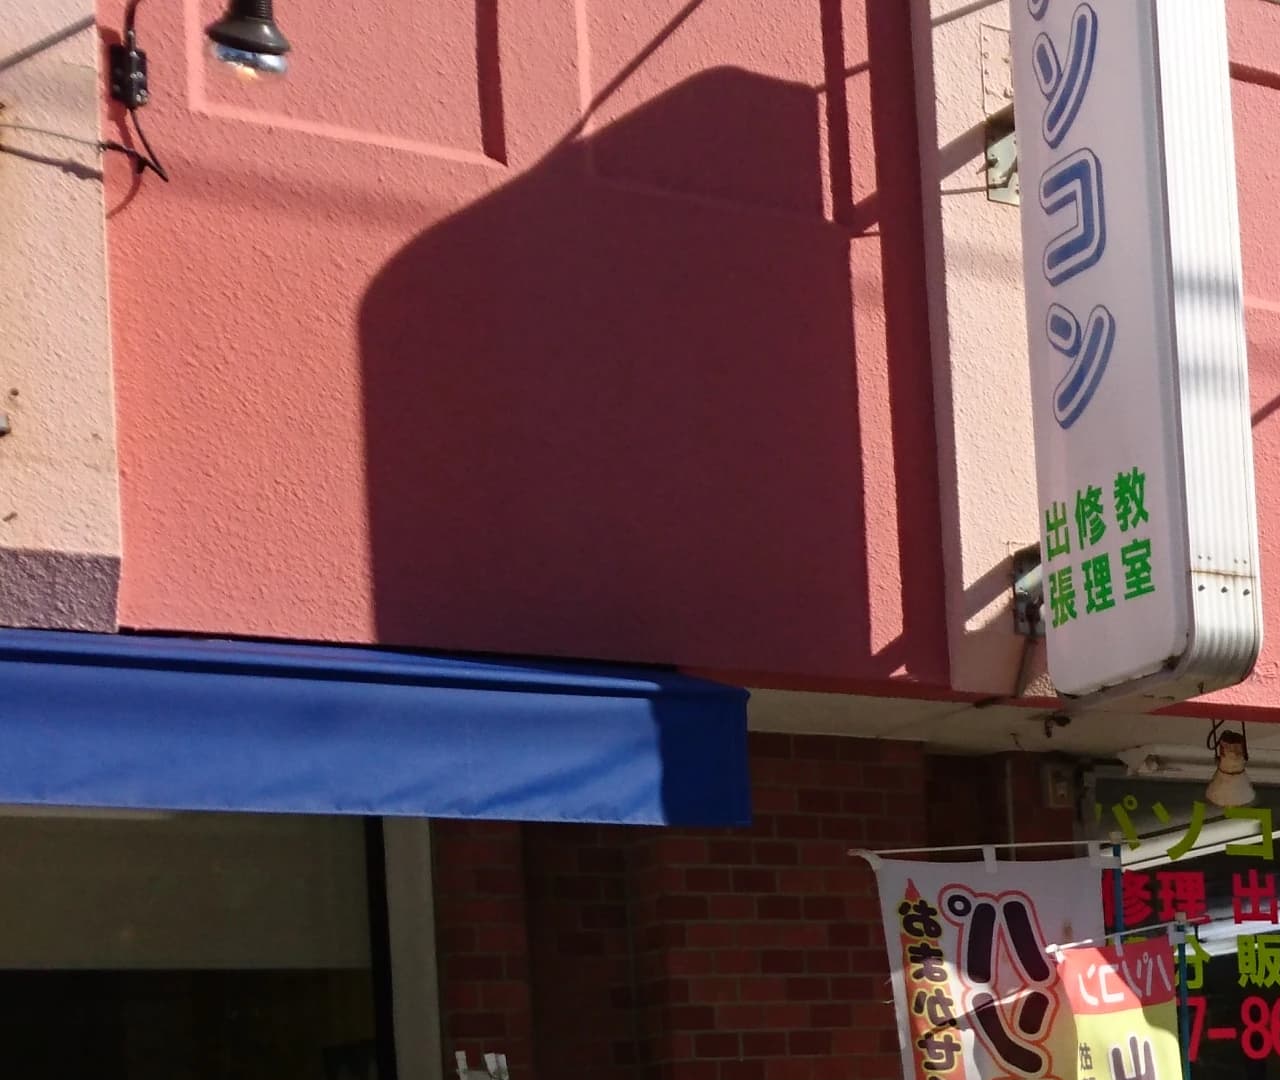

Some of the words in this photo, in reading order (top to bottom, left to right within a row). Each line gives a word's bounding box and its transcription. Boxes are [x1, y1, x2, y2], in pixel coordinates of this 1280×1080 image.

[1027, 0, 1116, 430] ソコン
[1044, 499, 1079, 630] 出張
[1073, 483, 1117, 615] 修理
[1113, 465, 1156, 602] 教室
[1101, 868, 1211, 928] 修理
